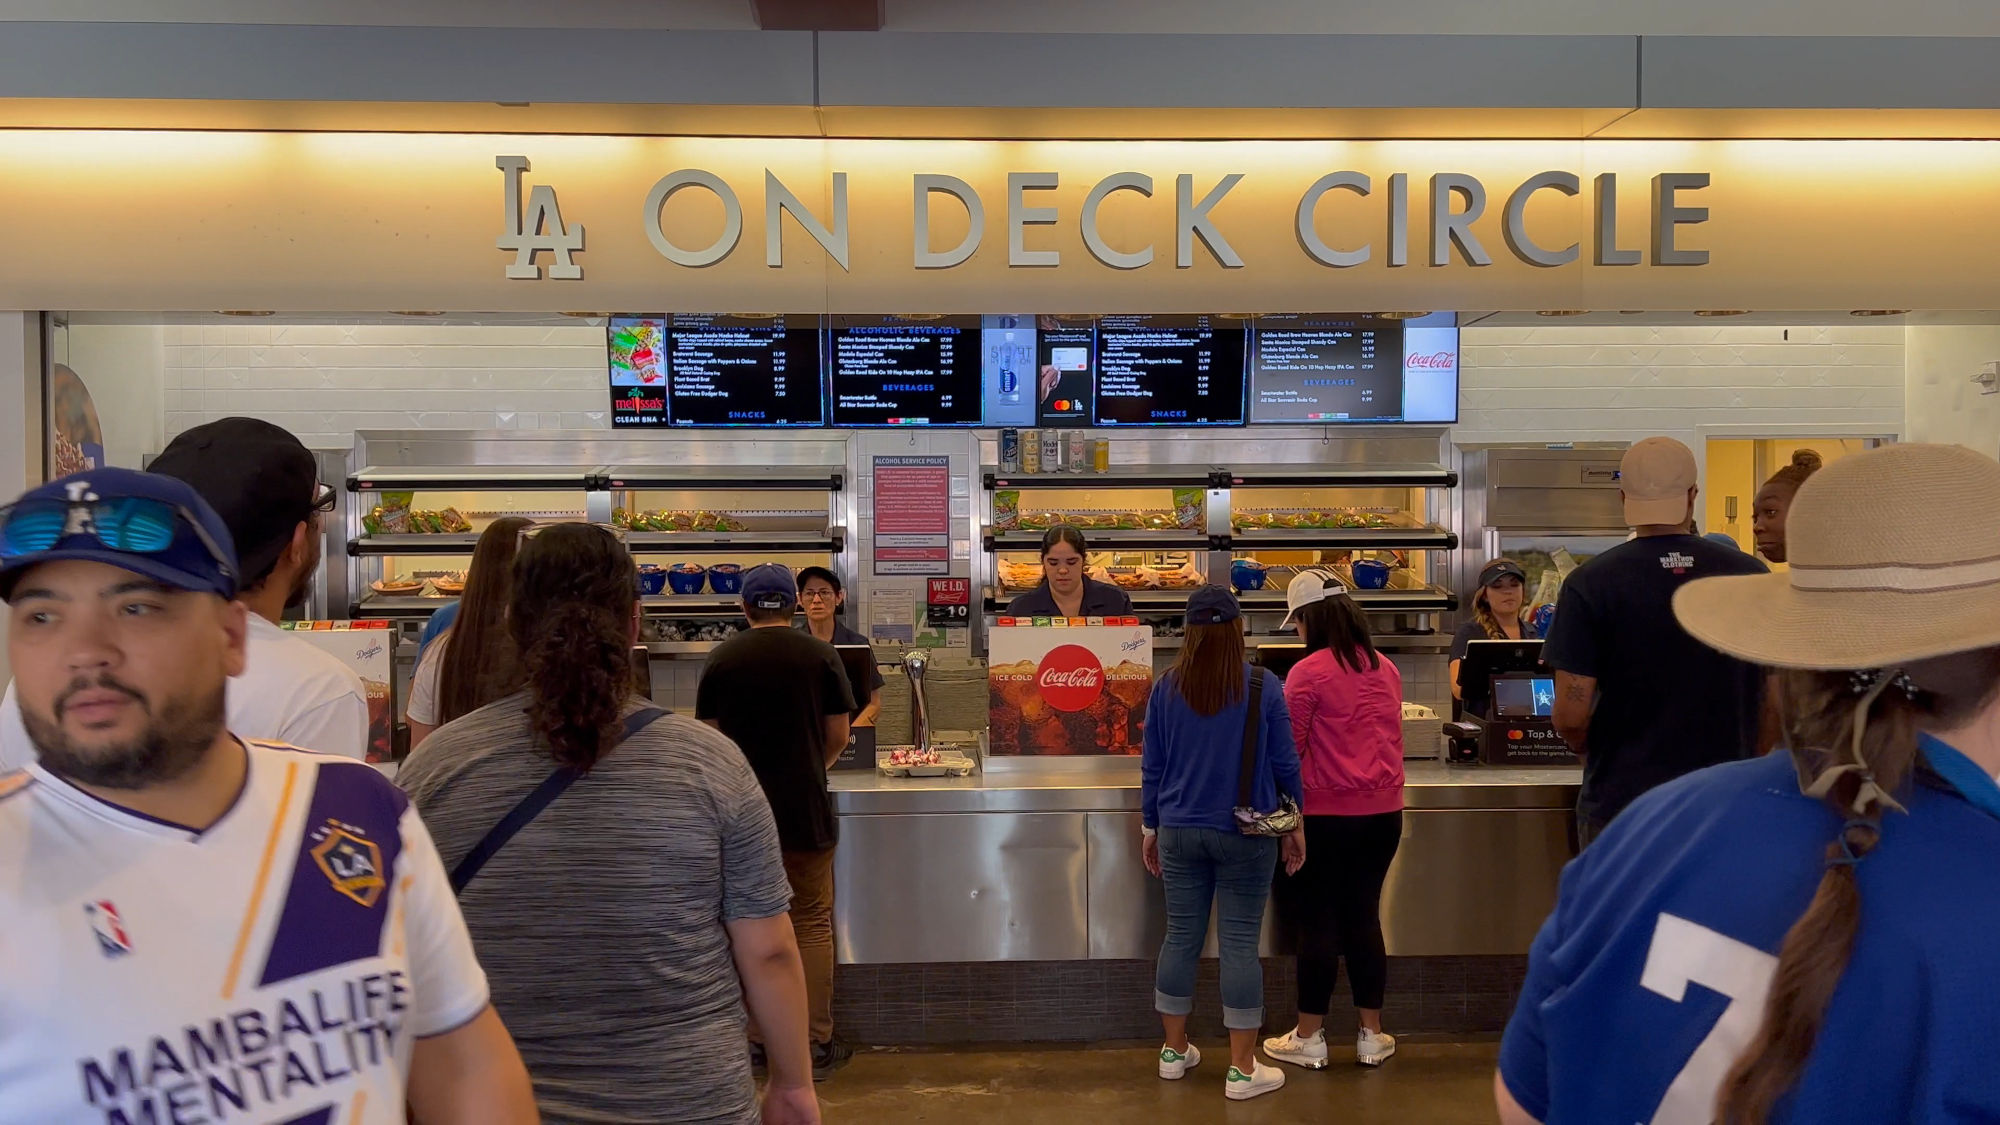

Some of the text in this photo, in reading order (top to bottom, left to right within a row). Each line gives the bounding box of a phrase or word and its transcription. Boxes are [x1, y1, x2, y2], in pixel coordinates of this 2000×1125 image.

[496, 155, 1710, 280] LA ON DECK CIRCLE
[932, 581, 965, 591] WE I.D.
[1121, 638, 1146, 651] Dodgers
[356, 646, 382, 660] Dodgers
[1528, 730, 1544, 740] Tap
[1546, 730, 1554, 738] &
[1640, 911, 1781, 1125] 7
[77, 970, 406, 1105] MAMBALIFE
